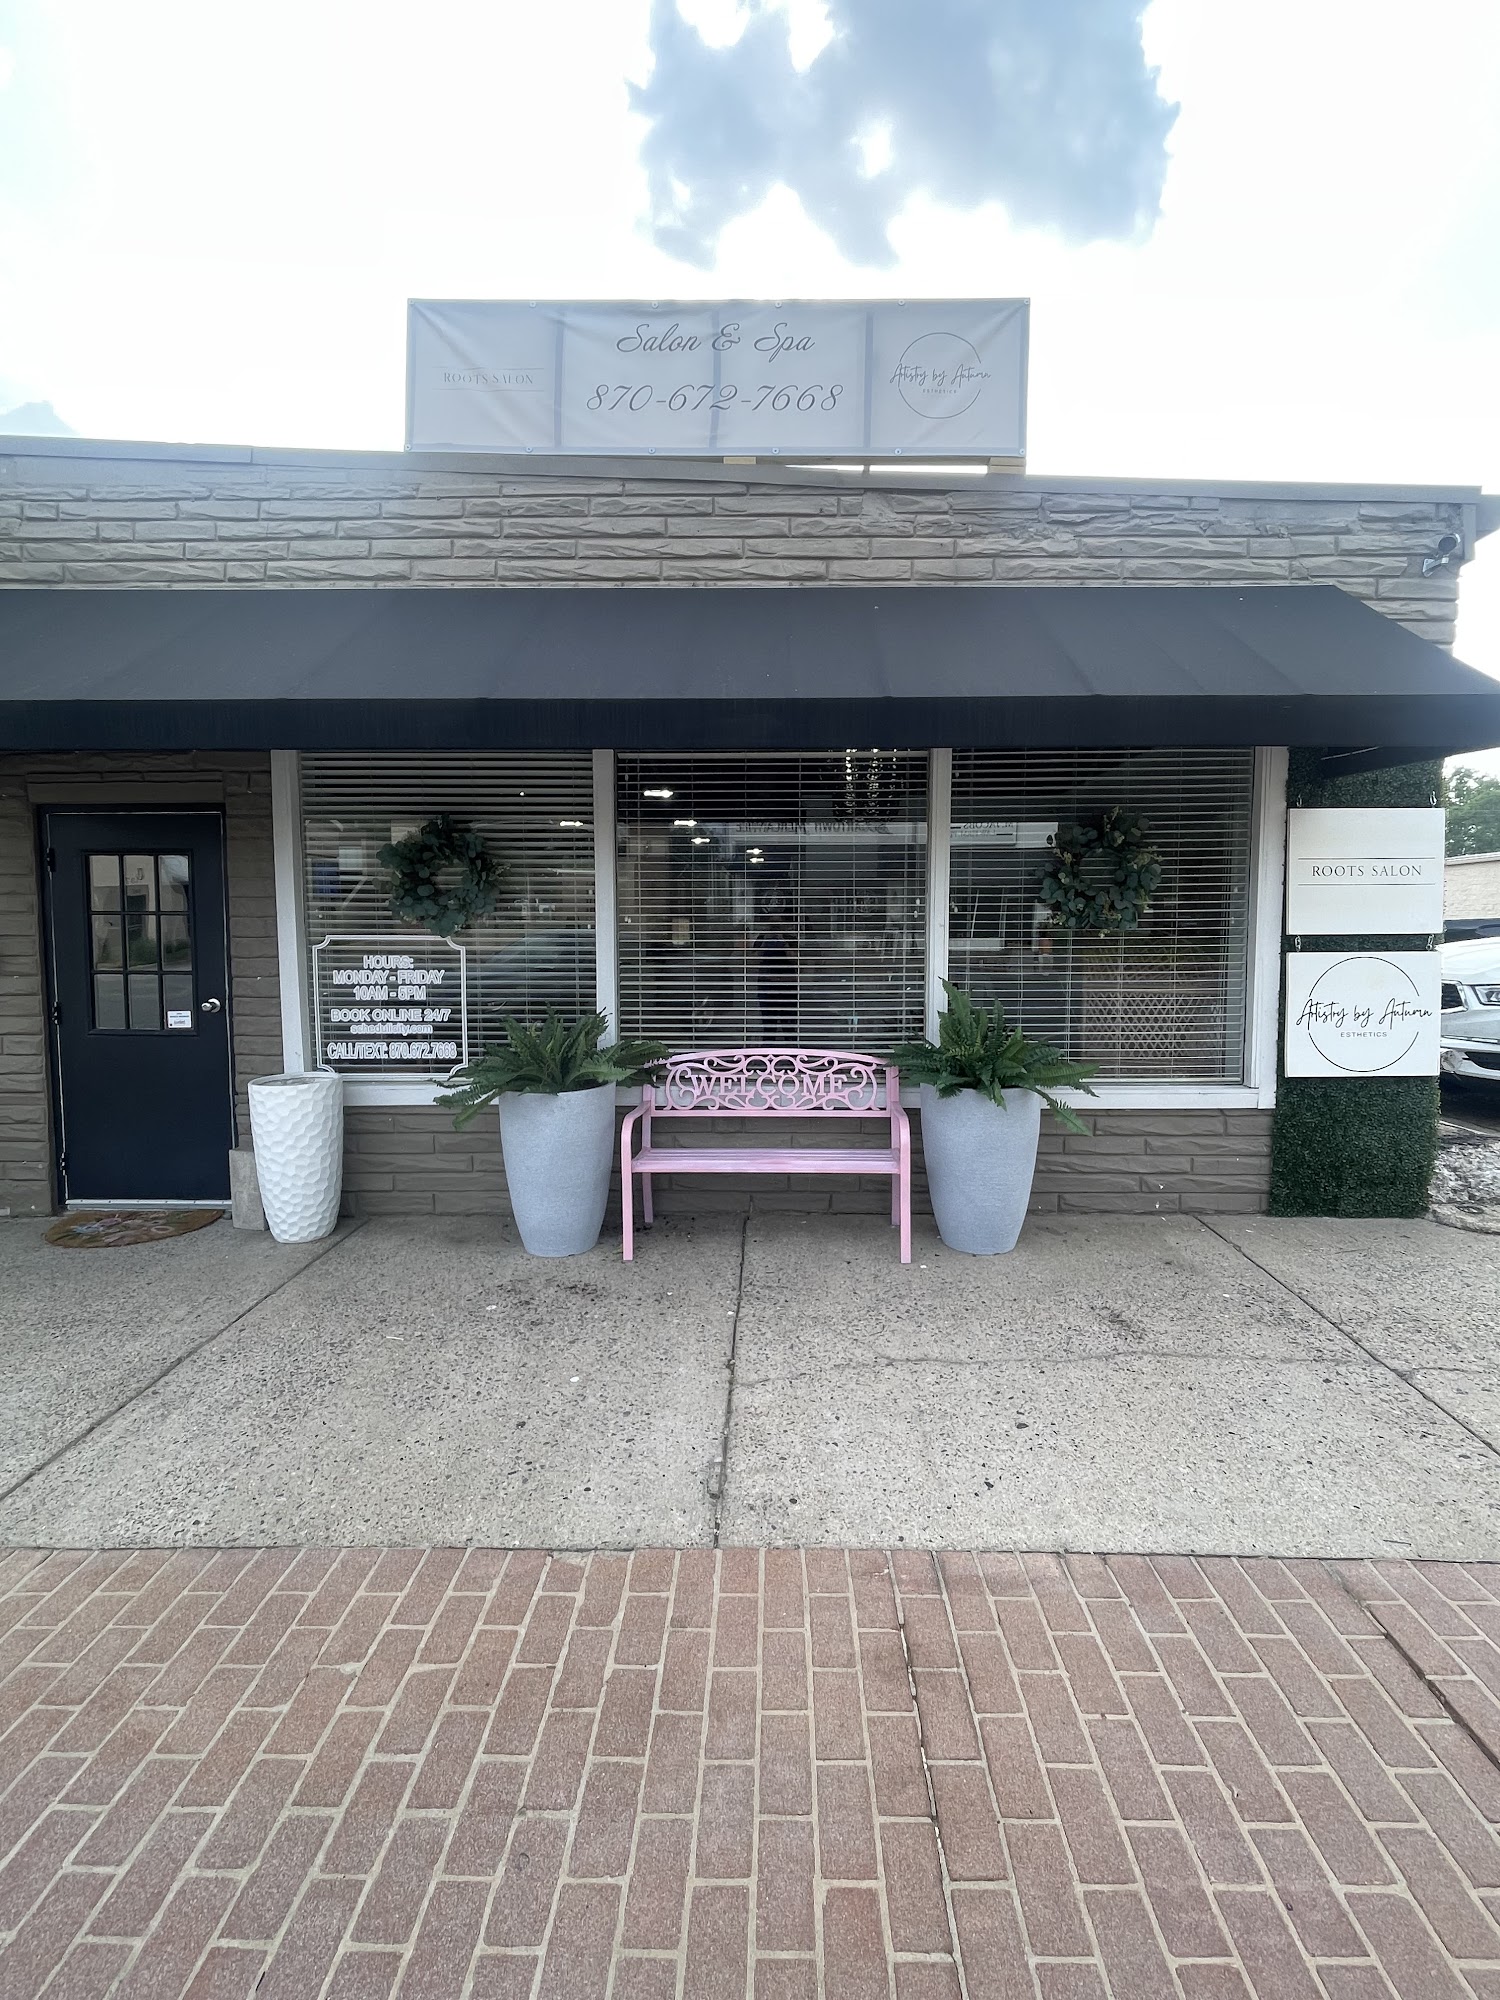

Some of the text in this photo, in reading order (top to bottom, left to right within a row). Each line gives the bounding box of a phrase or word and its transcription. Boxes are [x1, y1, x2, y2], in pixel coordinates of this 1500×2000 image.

[616, 322, 816, 363] Salon & Spa
[443, 372, 534, 385] ROOTS SALON
[889, 363, 992, 389] Artistry by Autumn
[586, 384, 844, 412] 870-672-7668
[1311, 864, 1423, 877] ROOTS SALON
[362, 955, 414, 969] HOURS:
[332, 970, 389, 984] MONDAY
[397, 970, 445, 984] FRIDAY
[353, 985, 389, 1000] 10AM
[397, 985, 426, 1000] 5PM
[330, 1008, 451, 1022] BOOK ONLINE 24/7
[1295, 997, 1433, 1031] Artistry by Autumn
[350, 1023, 433, 1036] schedulicity.com
[327, 1041, 457, 1059] CALL/TEXT: 870.672.7668
[690, 1073, 850, 1098] WELCOME
